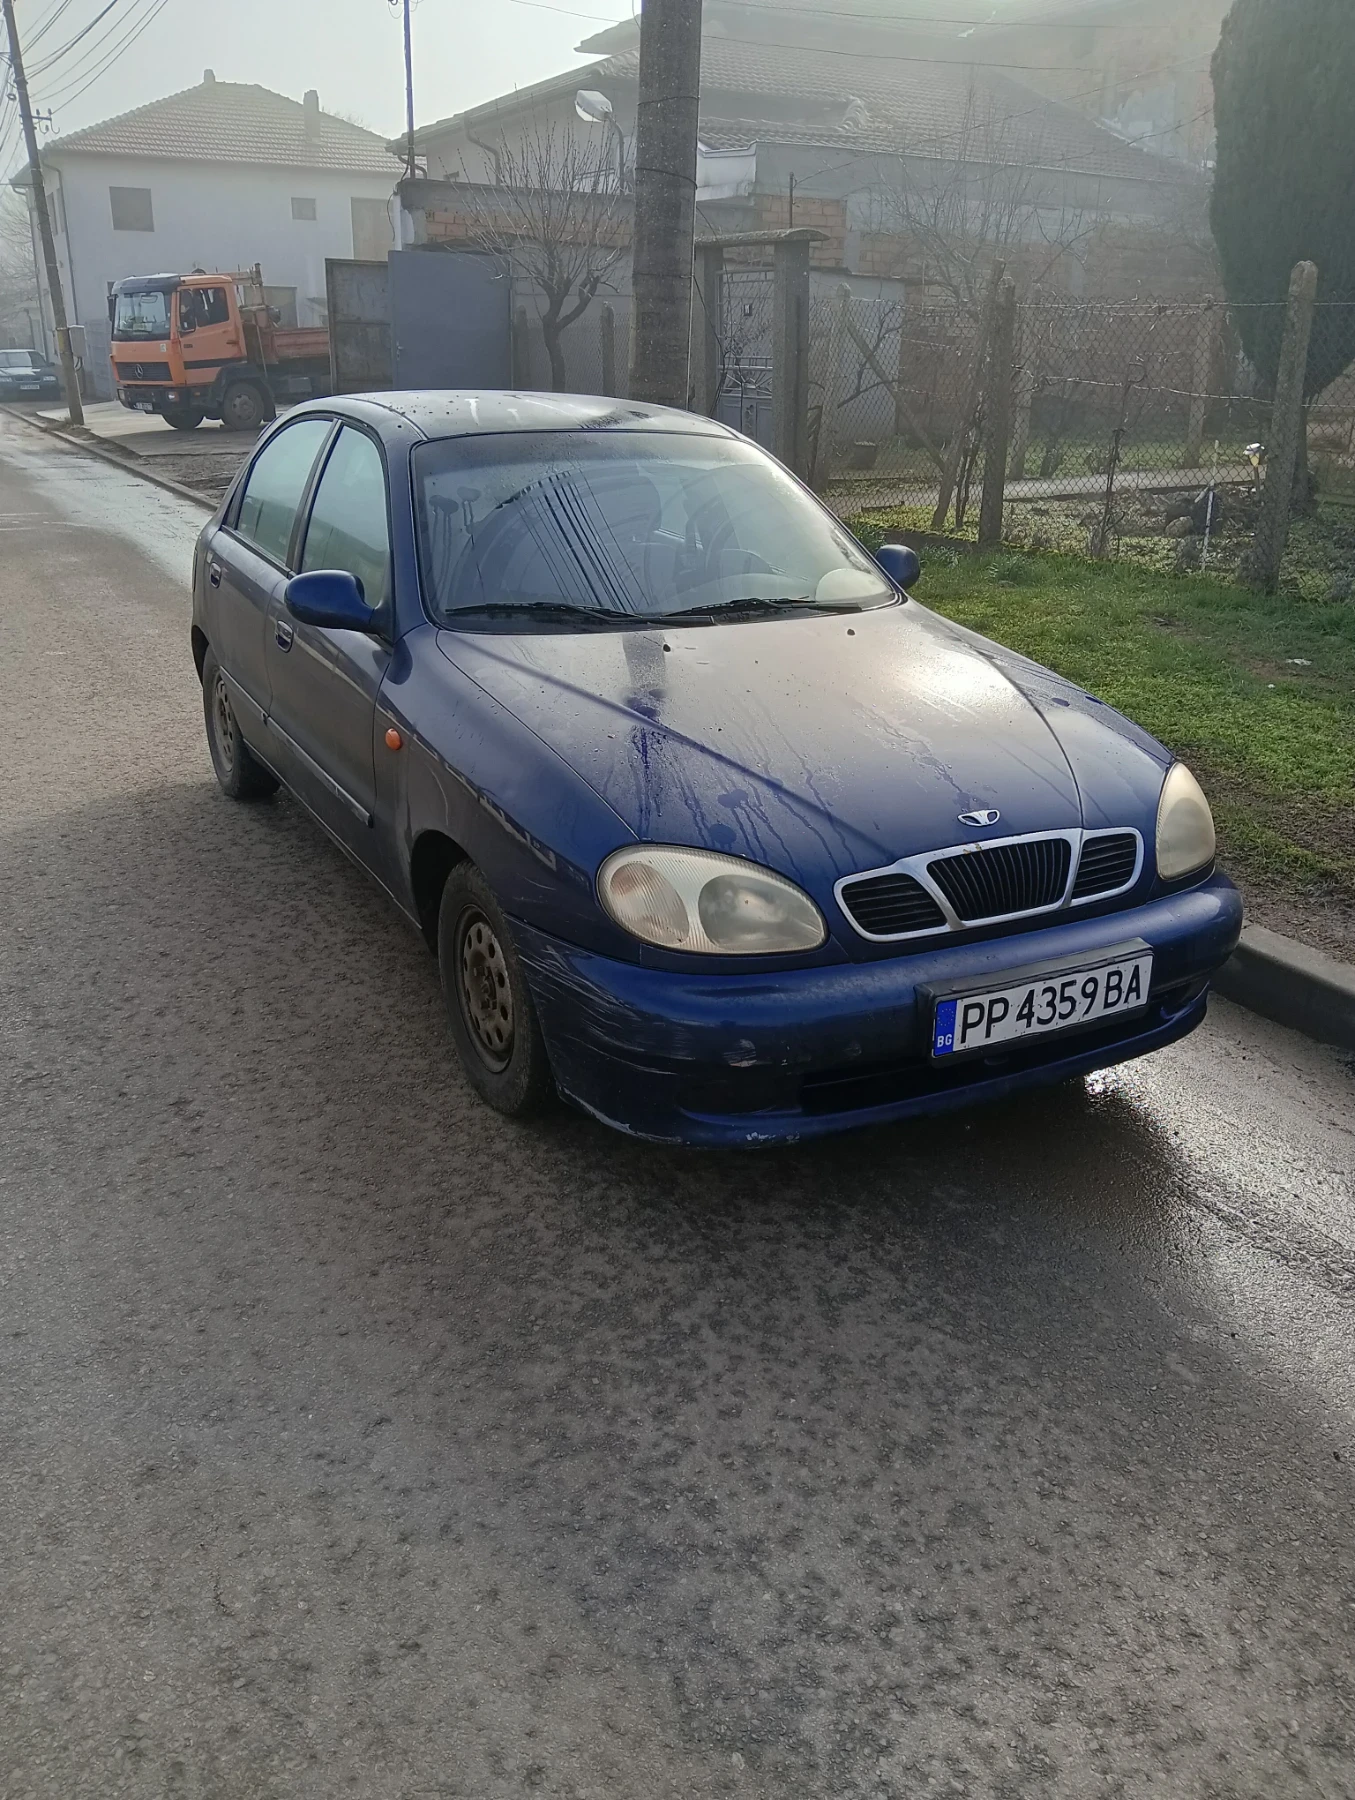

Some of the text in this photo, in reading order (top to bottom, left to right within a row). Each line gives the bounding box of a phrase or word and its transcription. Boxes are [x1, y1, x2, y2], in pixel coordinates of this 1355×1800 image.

[960, 964, 1141, 1044] PP 4359 BA
[937, 1034, 952, 1048] BG
